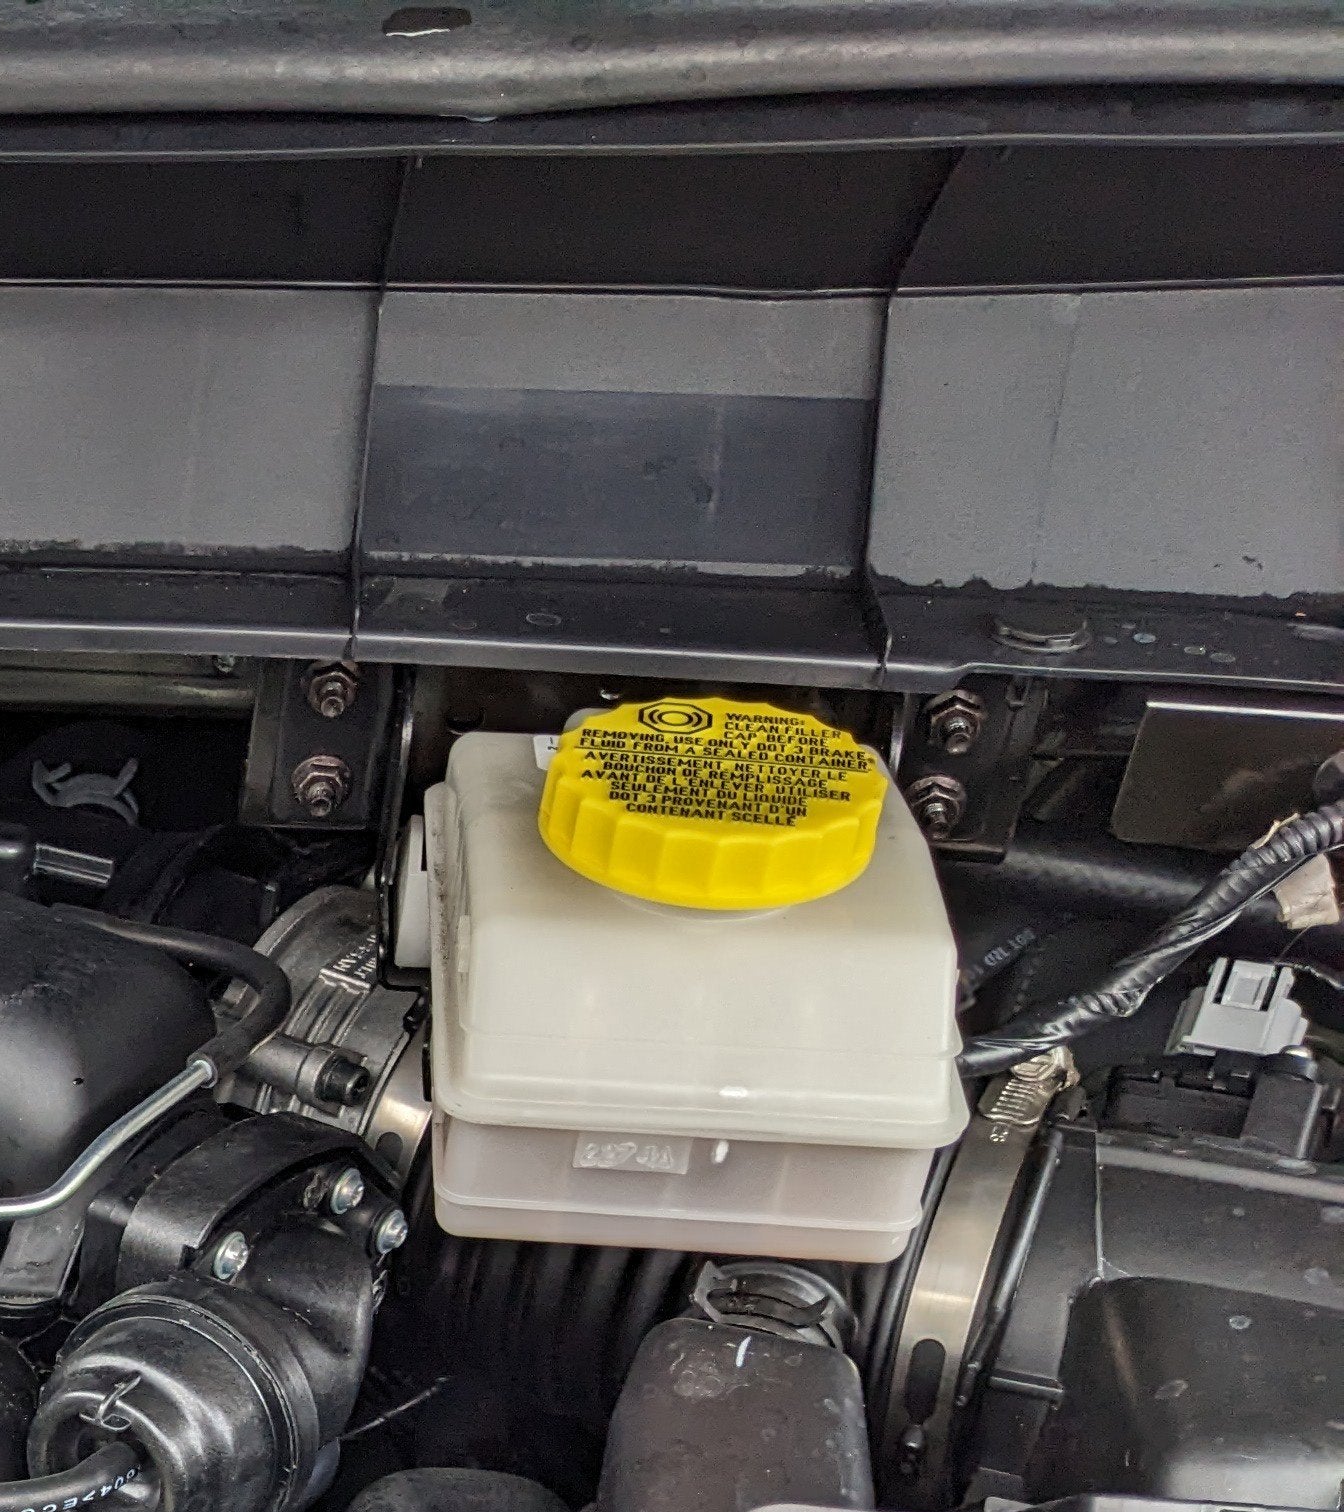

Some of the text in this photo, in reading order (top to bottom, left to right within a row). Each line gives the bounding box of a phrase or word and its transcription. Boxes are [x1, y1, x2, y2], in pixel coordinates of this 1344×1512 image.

[724, 721, 841, 739] CLEAN FILLER
[726, 712, 805, 726] WARNING:
[580, 737, 626, 749] FLUID
[633, 741, 679, 754] FROM
[685, 745, 696, 755] A
[702, 747, 769, 761] SEALED
[673, 735, 704, 746] USE
[707, 739, 749, 750] ONLY
[756, 742, 787, 753] DOT
[794, 745, 804, 754] 3
[809, 746, 866, 761] BRAKE
[723, 731, 828, 747] CAP BEFORE
[603, 761, 828, 789] BOUCHON DE REMPLISSAGE
[734, 763, 820, 778] NETTOYER
[827, 771, 848, 782] LE
[581, 769, 639, 782] AVANT
[646, 775, 666, 785] DE
[775, 786, 851, 801] UTILISER
[611, 781, 807, 806] SEULEMENT DU LIQUIDE
[609, 791, 807, 817] DOT 3 PROVENANT D'UN
[626, 802, 724, 820] CONTENANT
